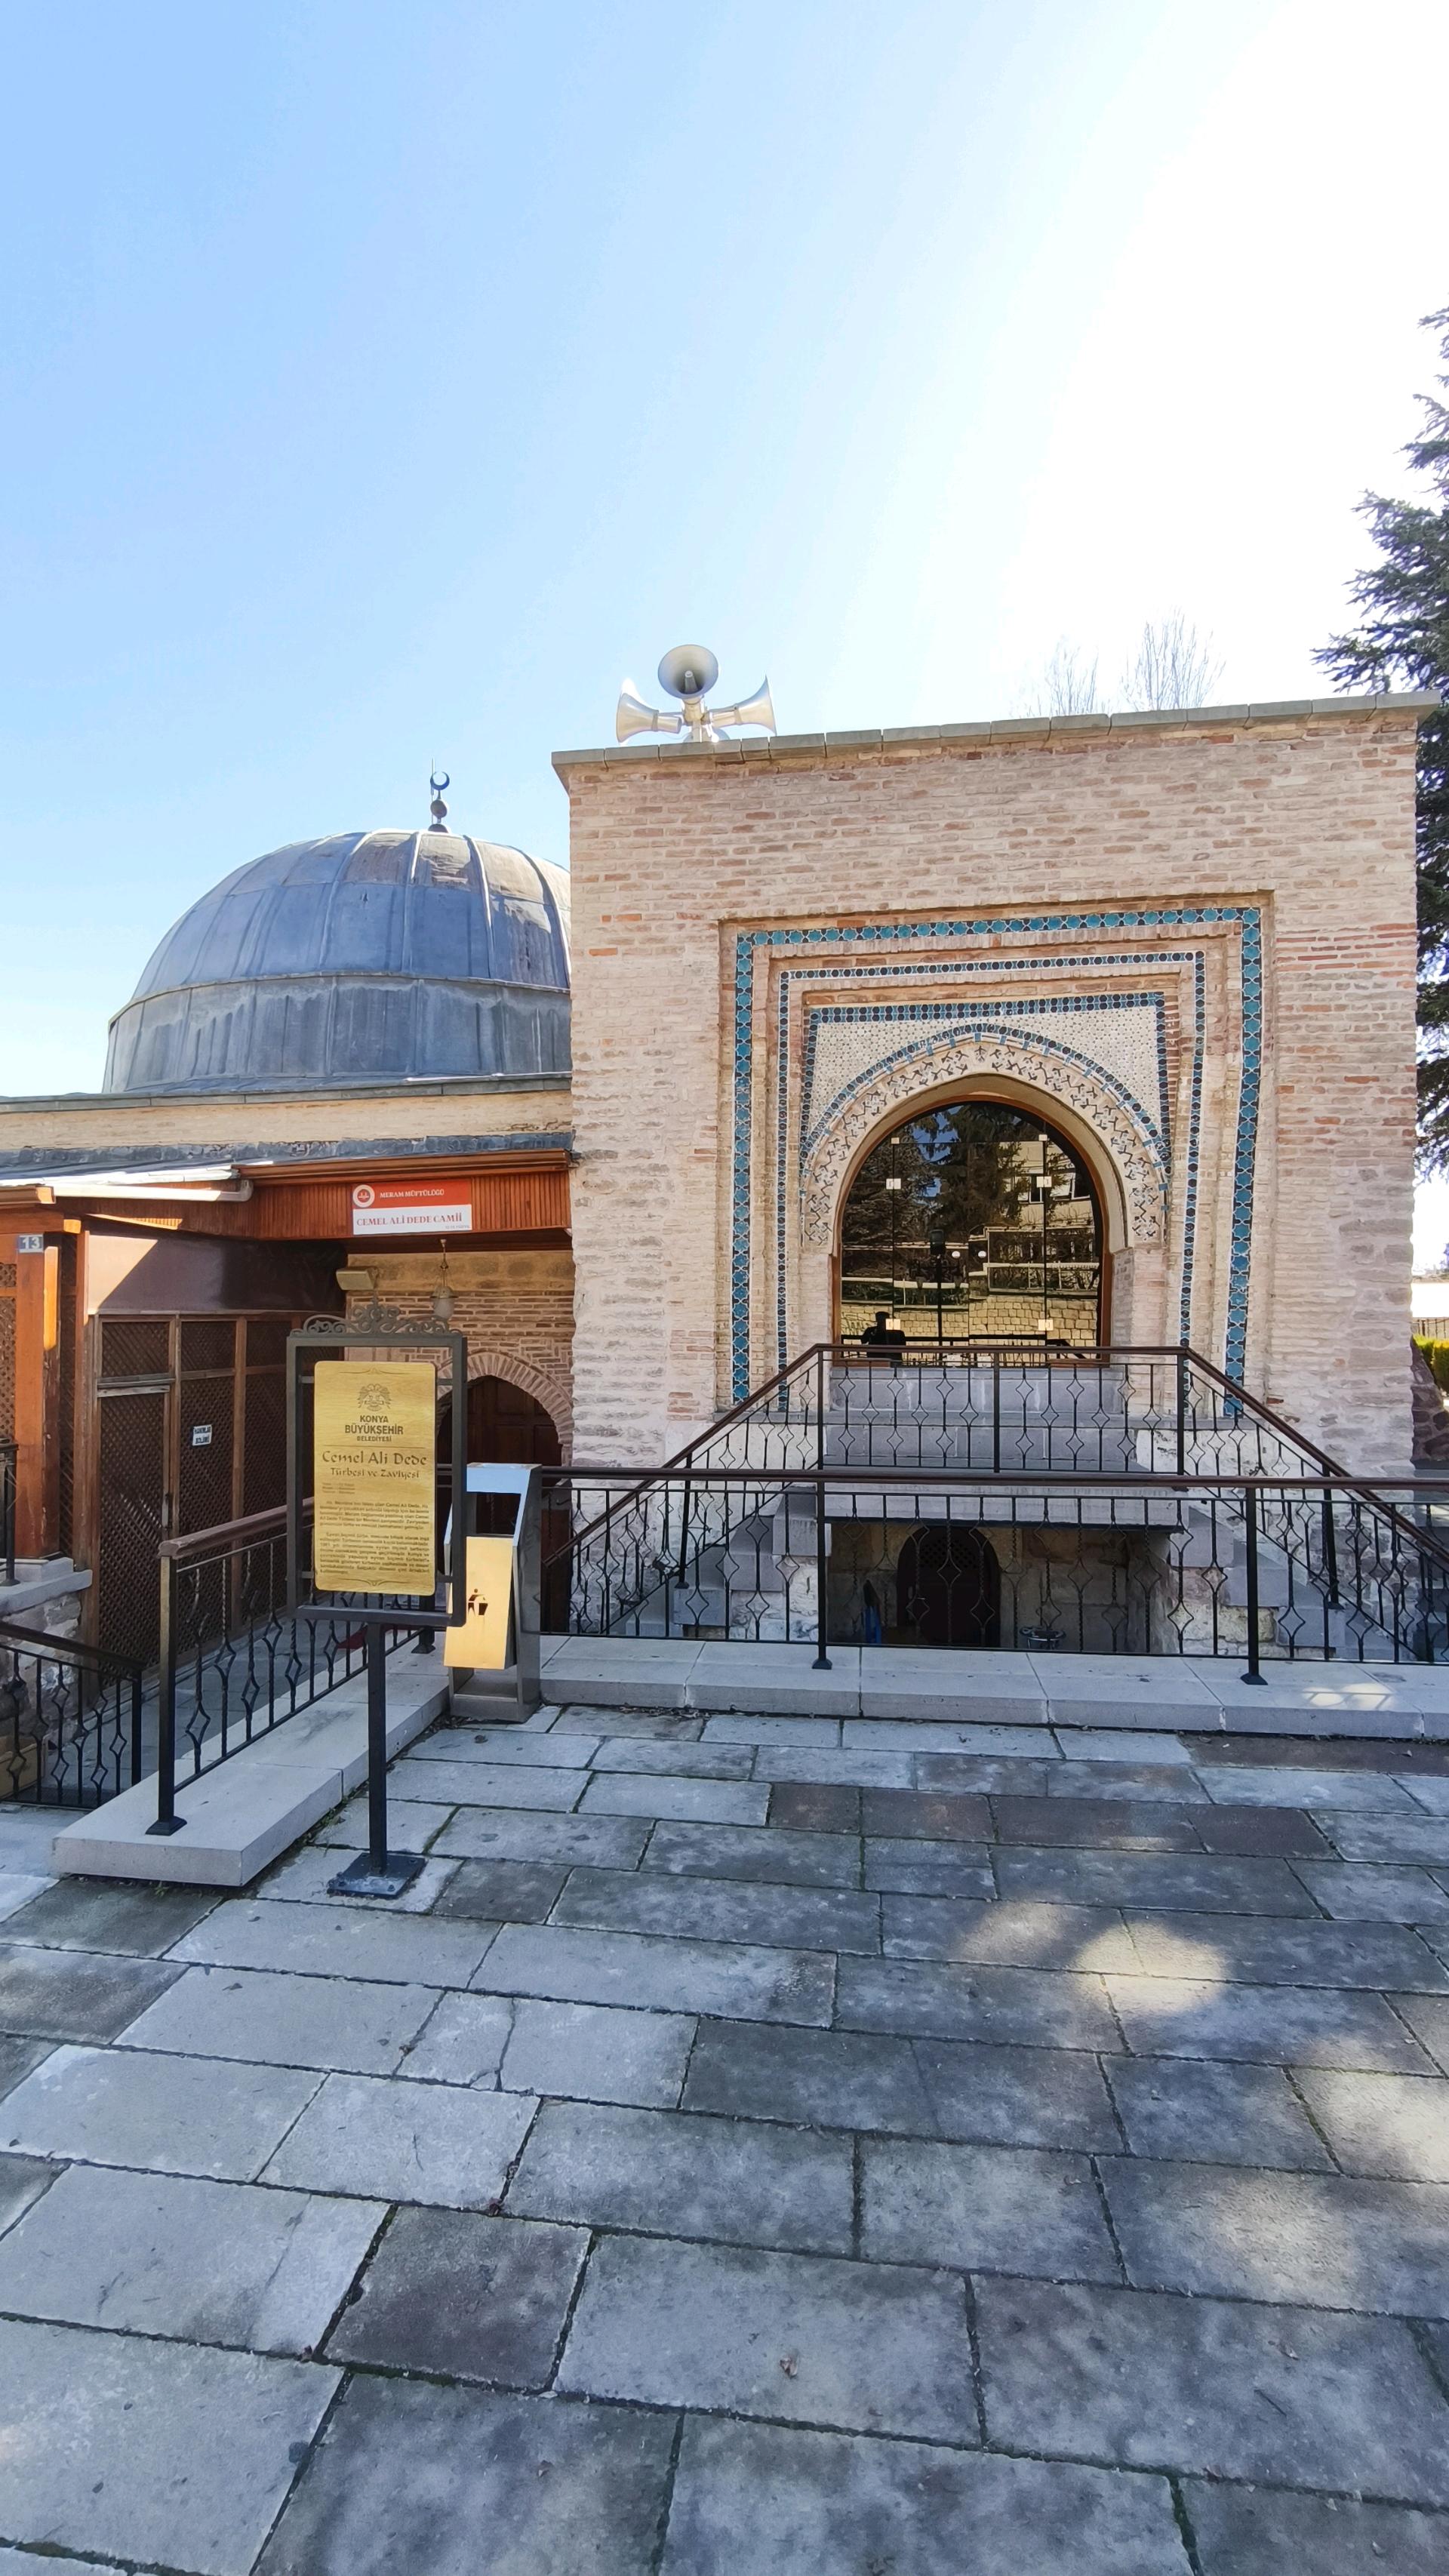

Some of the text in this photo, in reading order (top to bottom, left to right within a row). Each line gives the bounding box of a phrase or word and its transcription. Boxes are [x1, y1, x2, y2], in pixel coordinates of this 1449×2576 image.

[380, 1190, 404, 1199] MERAM
[356, 1212, 463, 1226] CEMEL ALİ DEDE CAMİİ
[23, 1236, 40, 1249] 13
[345, 1423, 404, 1436] BÜYÜKŞEHİR
[322, 1450, 428, 1466] Cemel Ali Dede
[331, 1467, 365, 1477] Türbesi
[380, 1469, 420, 1480] Zaviyesi
